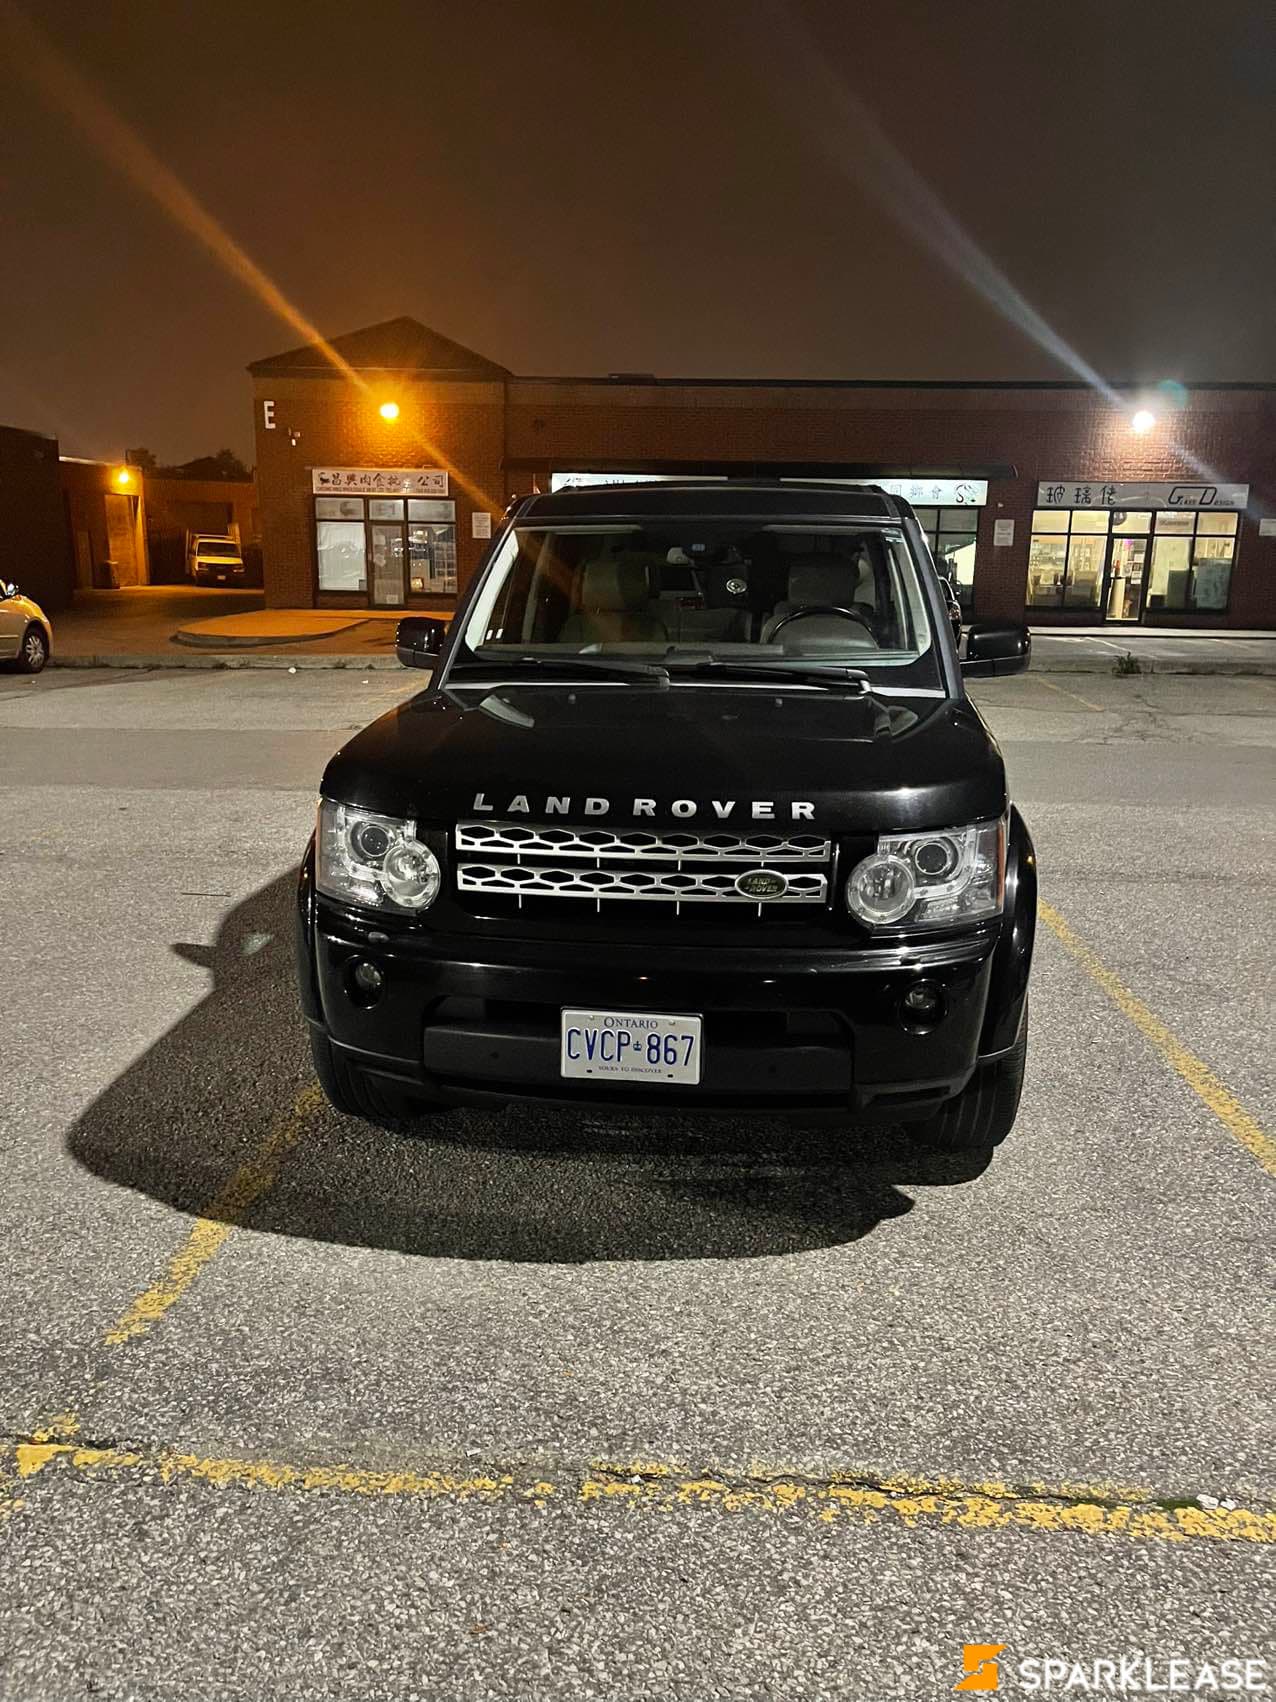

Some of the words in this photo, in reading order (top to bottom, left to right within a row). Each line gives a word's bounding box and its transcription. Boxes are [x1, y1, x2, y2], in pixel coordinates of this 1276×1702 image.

[264, 401, 276, 429] E
[473, 793, 610, 815] LAND
[632, 798, 816, 820] ROVER
[603, 1016, 658, 1029] ONTARIO
[567, 1028, 631, 1062] CVCP
[646, 1033, 695, 1067] 867
